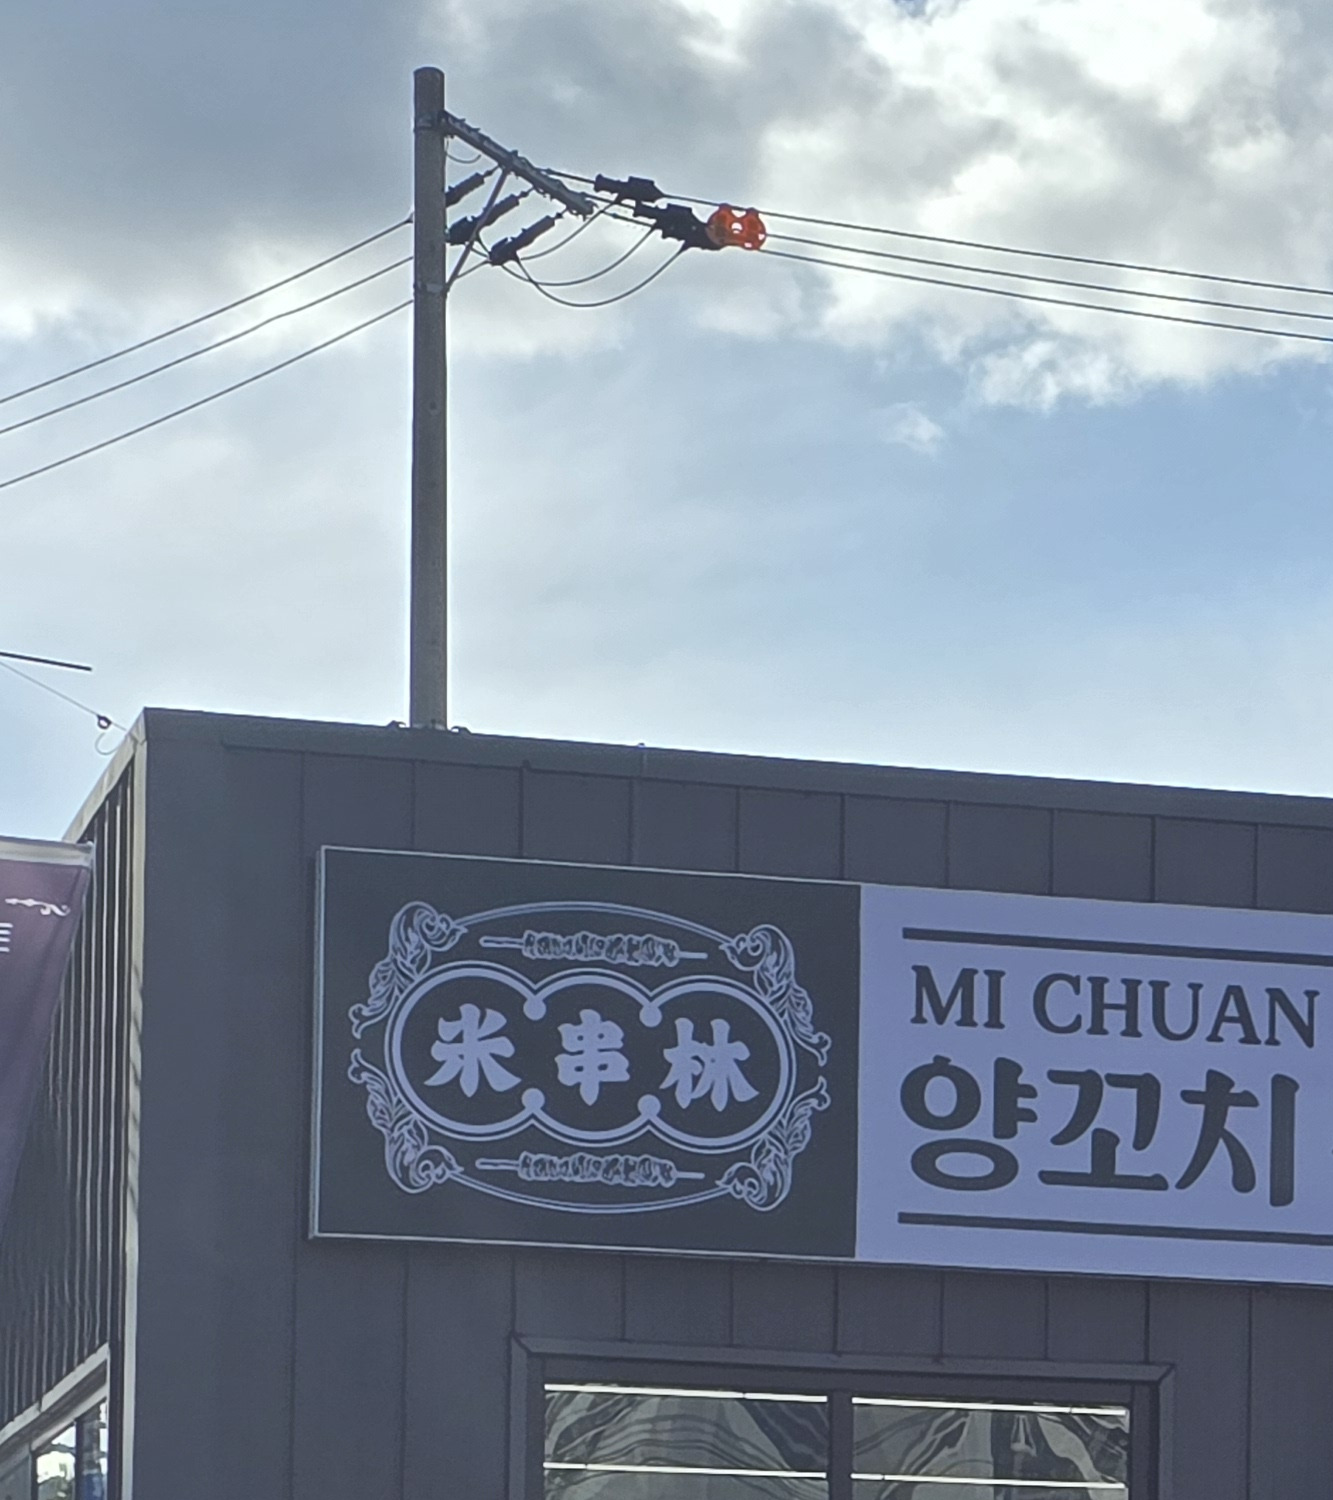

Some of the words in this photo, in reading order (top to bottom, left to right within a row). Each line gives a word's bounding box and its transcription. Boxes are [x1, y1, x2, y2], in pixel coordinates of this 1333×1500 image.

[424, 1002, 759, 1112] 米串林
[909, 963, 1006, 1029] MI
[1031, 970, 1319, 1048] CHUAN
[899, 1053, 1301, 1207] 양꼬치
